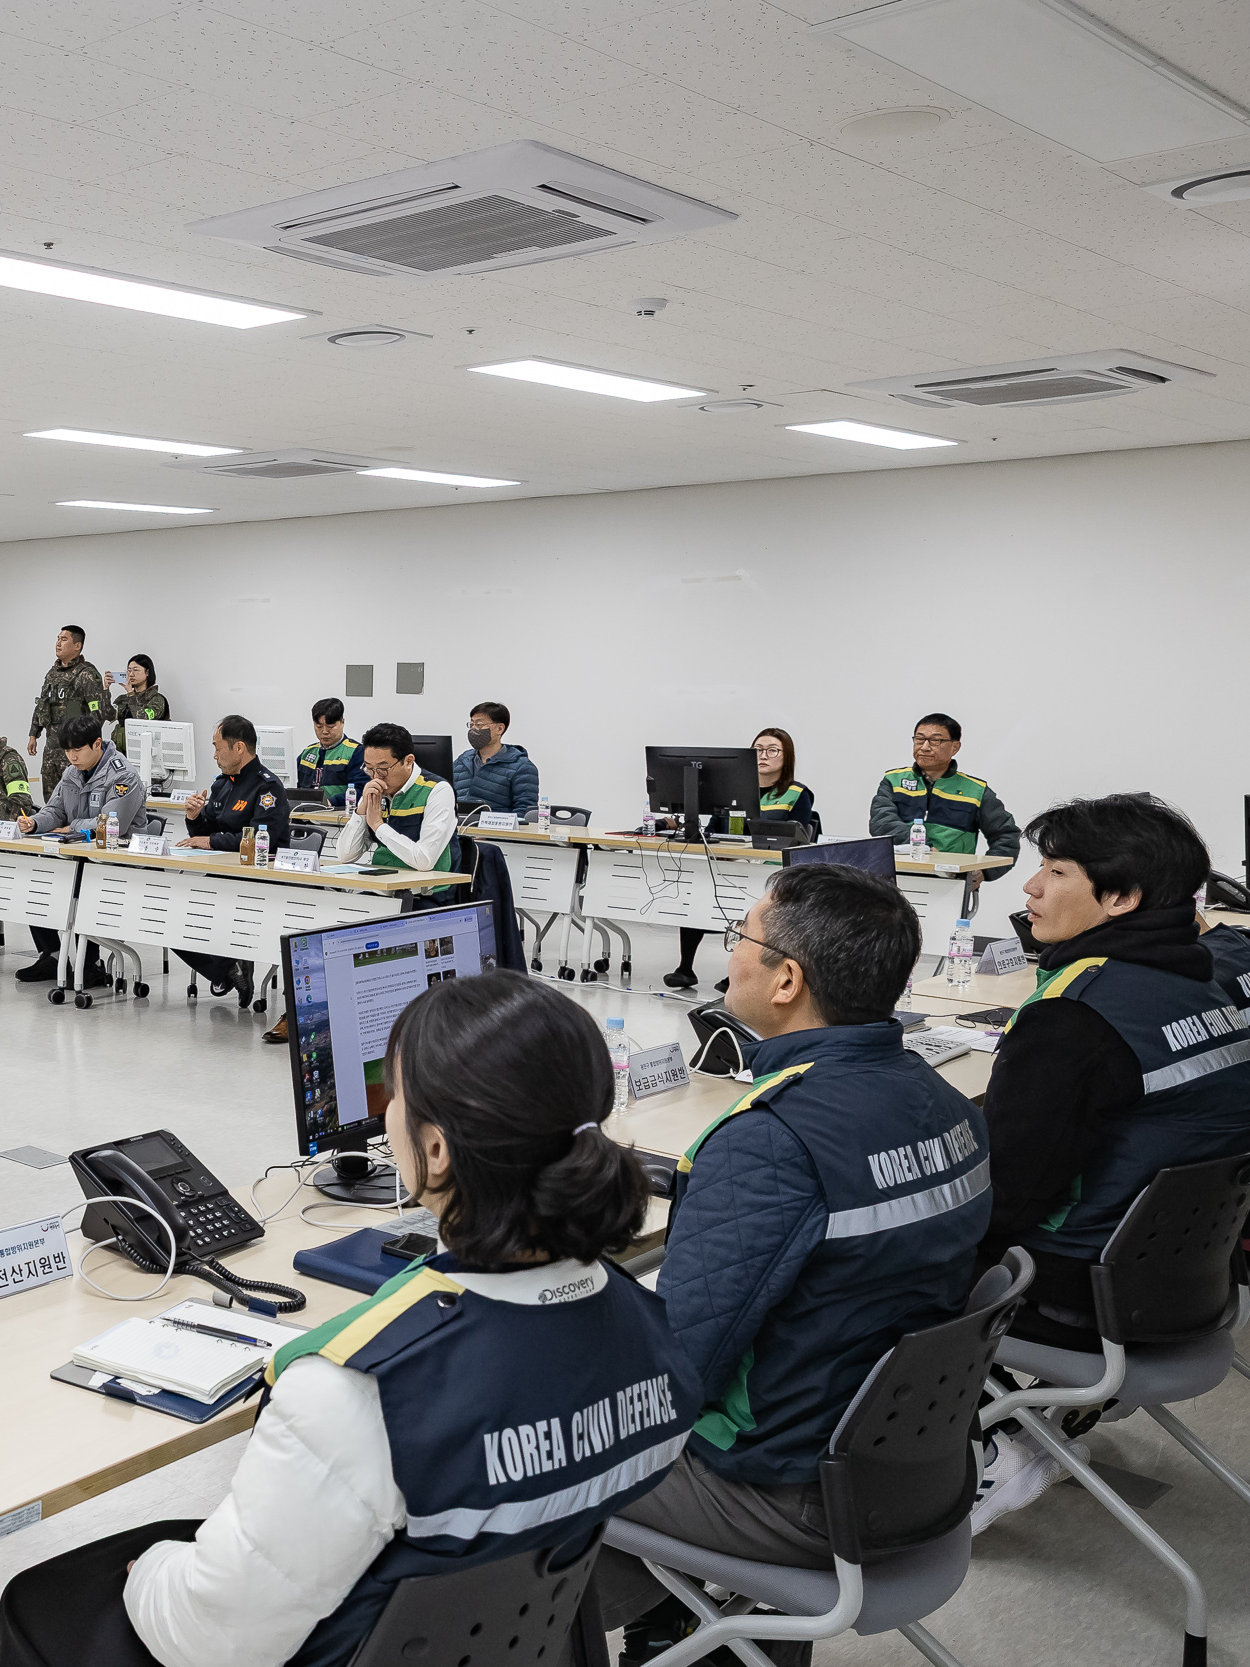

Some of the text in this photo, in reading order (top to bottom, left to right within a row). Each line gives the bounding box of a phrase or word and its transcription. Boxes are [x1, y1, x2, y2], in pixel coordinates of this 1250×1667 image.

[691, 761, 703, 770] TG
[1161, 1015, 1210, 1052] KOREA
[1201, 1008, 1233, 1037] CIVIL
[634, 1066, 686, 1092] 보급급식지원반
[868, 1145, 922, 1189] KOREA
[917, 1137, 950, 1175] CIVIL
[483, 1417, 567, 1486] KOREA
[616, 1373, 678, 1440] DEFENSE
